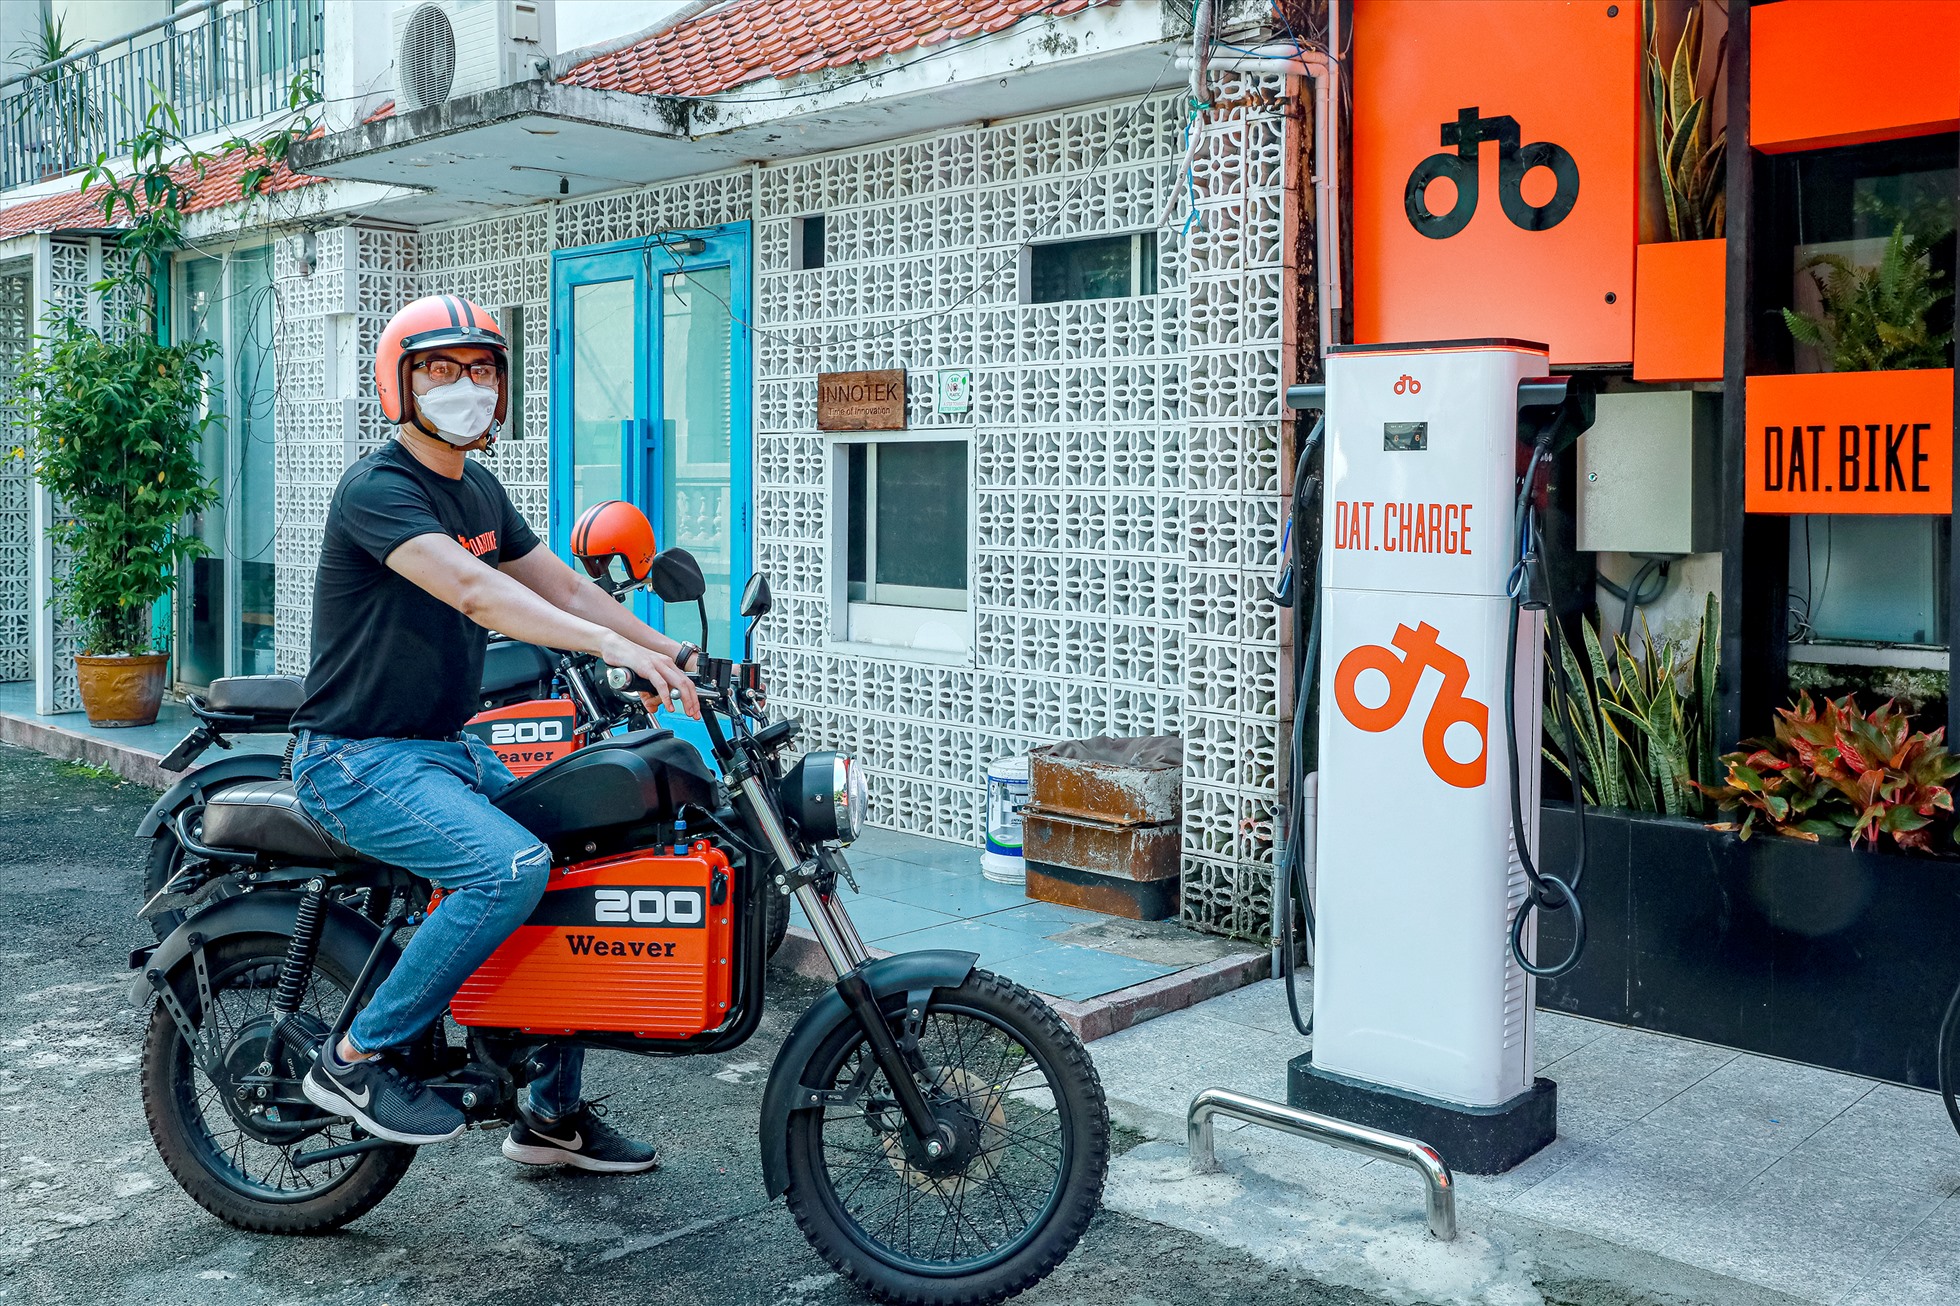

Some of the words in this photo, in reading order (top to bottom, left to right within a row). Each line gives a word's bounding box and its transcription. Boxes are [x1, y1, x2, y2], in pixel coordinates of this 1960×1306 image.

[822, 383, 898, 403] INNOTEK
[846, 406, 854, 416] of
[1765, 423, 1931, 492] DAT.BIKE
[1335, 501, 1473, 555] DAT.CHARGE
[491, 721, 563, 744] 200
[495, 751, 554, 763] eaver
[594, 889, 702, 924] 200
[565, 935, 676, 957] Weaver
